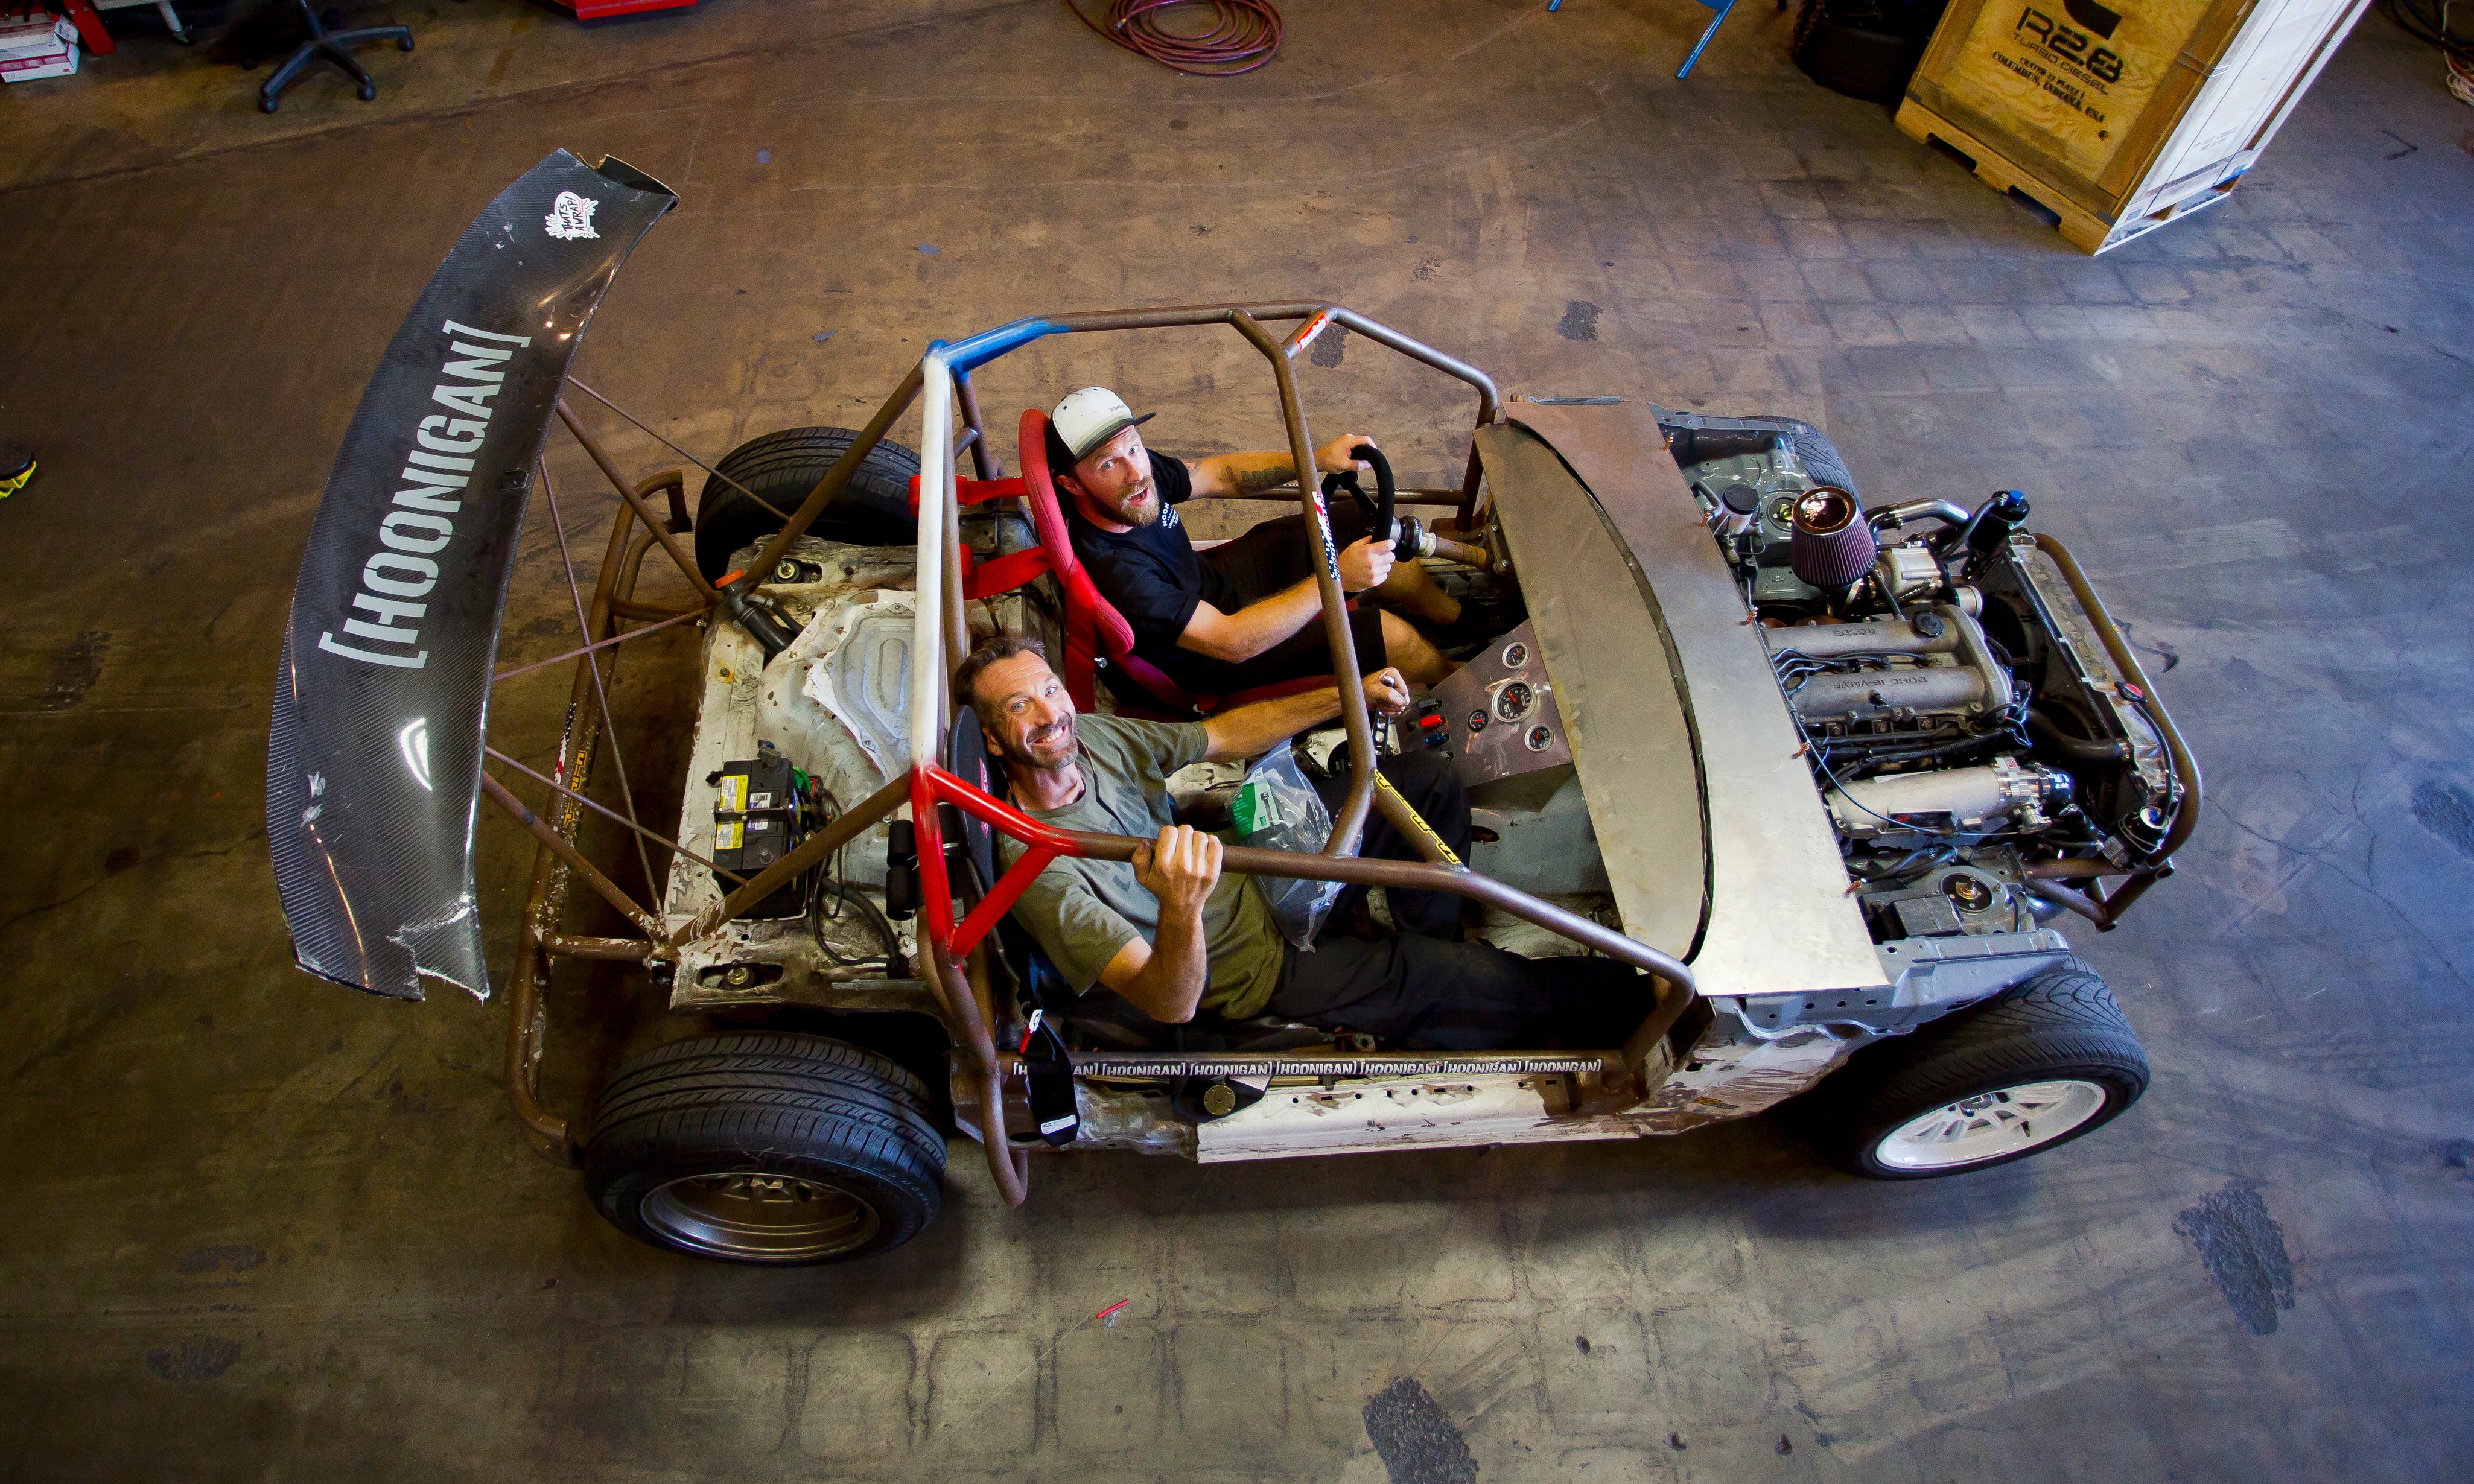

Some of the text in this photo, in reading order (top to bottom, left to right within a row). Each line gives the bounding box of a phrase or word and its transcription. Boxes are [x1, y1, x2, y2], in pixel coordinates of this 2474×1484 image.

[2015, 5, 2123, 84] R2.8
[2014, 31, 2109, 95] TURBO DIESEL
[2085, 106, 2105, 124] USA
[558, 203, 574, 232] THAT'S
[565, 195, 584, 224] WRAP!
[318, 319, 532, 669] [HOONIGAN]
[1834, 676, 1928, 689] DOHC 16-VALVE
[1102, 1062, 1186, 1076] [HOONIGAN]
[1189, 1061, 1273, 1076] [HOONIGAN]
[1276, 1060, 1357, 1075] [HOONIGAN]
[1525, 1059, 1601, 1073] [HOONIGAN]
